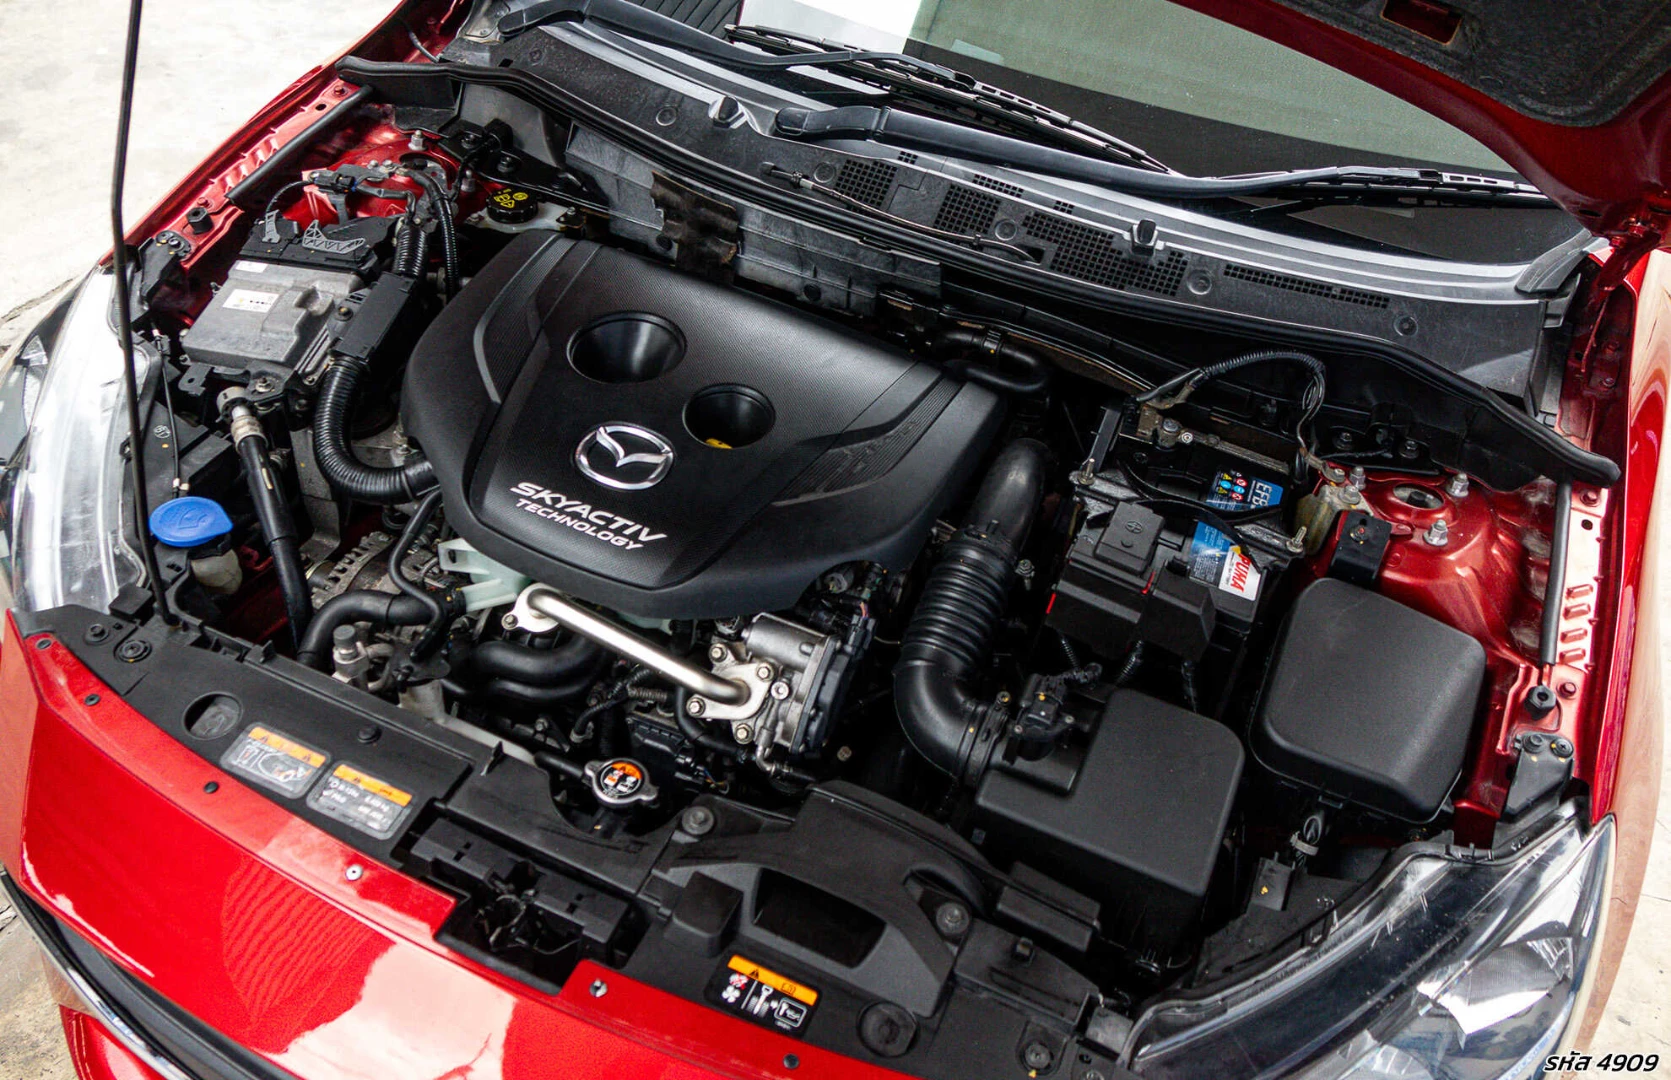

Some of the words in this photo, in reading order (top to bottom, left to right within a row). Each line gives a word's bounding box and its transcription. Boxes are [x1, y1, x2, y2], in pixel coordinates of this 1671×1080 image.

[510, 482, 667, 542] SKYACTIV
[516, 498, 643, 550] TECHNOLOGY
[1230, 553, 1251, 593] PUMA
